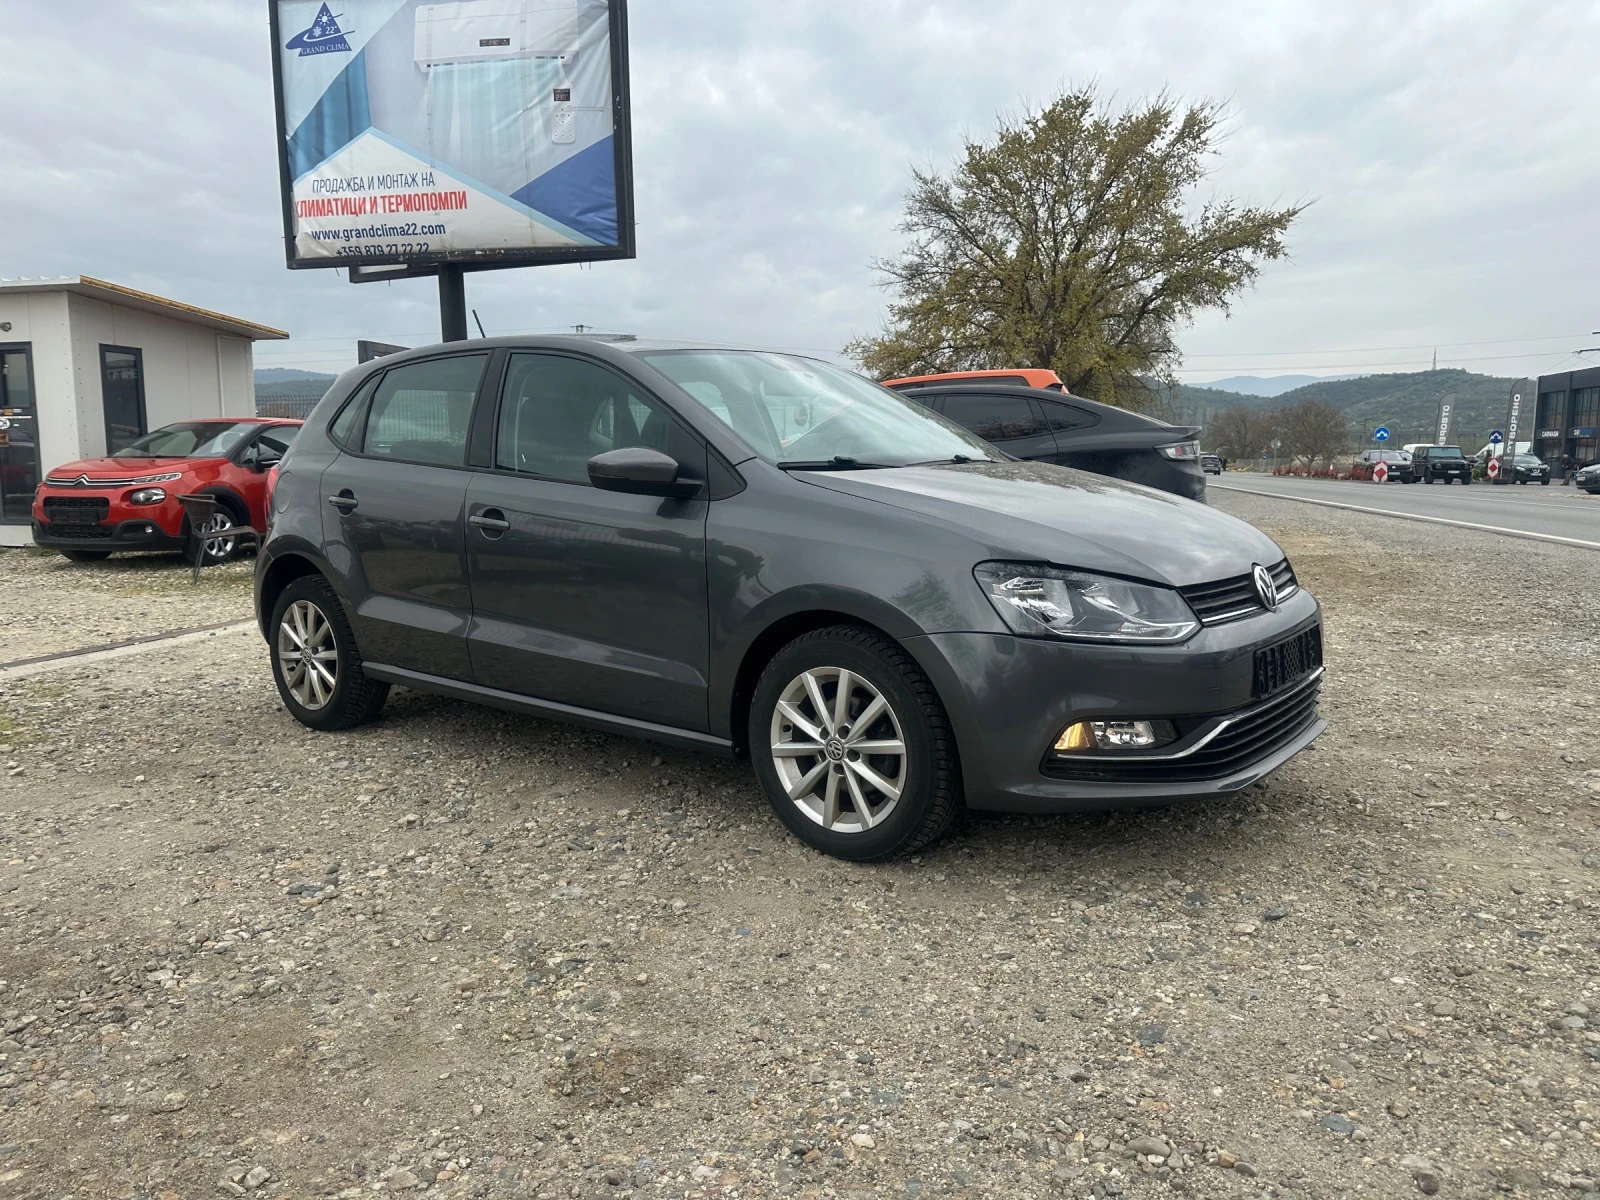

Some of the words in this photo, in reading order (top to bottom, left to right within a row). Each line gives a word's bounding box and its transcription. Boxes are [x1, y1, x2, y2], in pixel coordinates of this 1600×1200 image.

[301, 46, 325, 55] GRAND
[327, 43, 349, 51] CLIMA
[312, 176, 366, 194] ПРОДАЖБА
[367, 175, 375, 190] И
[377, 172, 419, 190] МОНТАЖ
[421, 171, 436, 187] НА
[369, 195, 378, 214] И
[380, 191, 467, 213] ТЕРМОПОМПИ
[311, 223, 446, 241] www.grandclima22.com
[336, 245, 362, 257] +359
[364, 244, 385, 256] 879
[386, 243, 399, 254] 27
[401, 242, 414, 254] 22
[416, 242, 430, 253] 22
